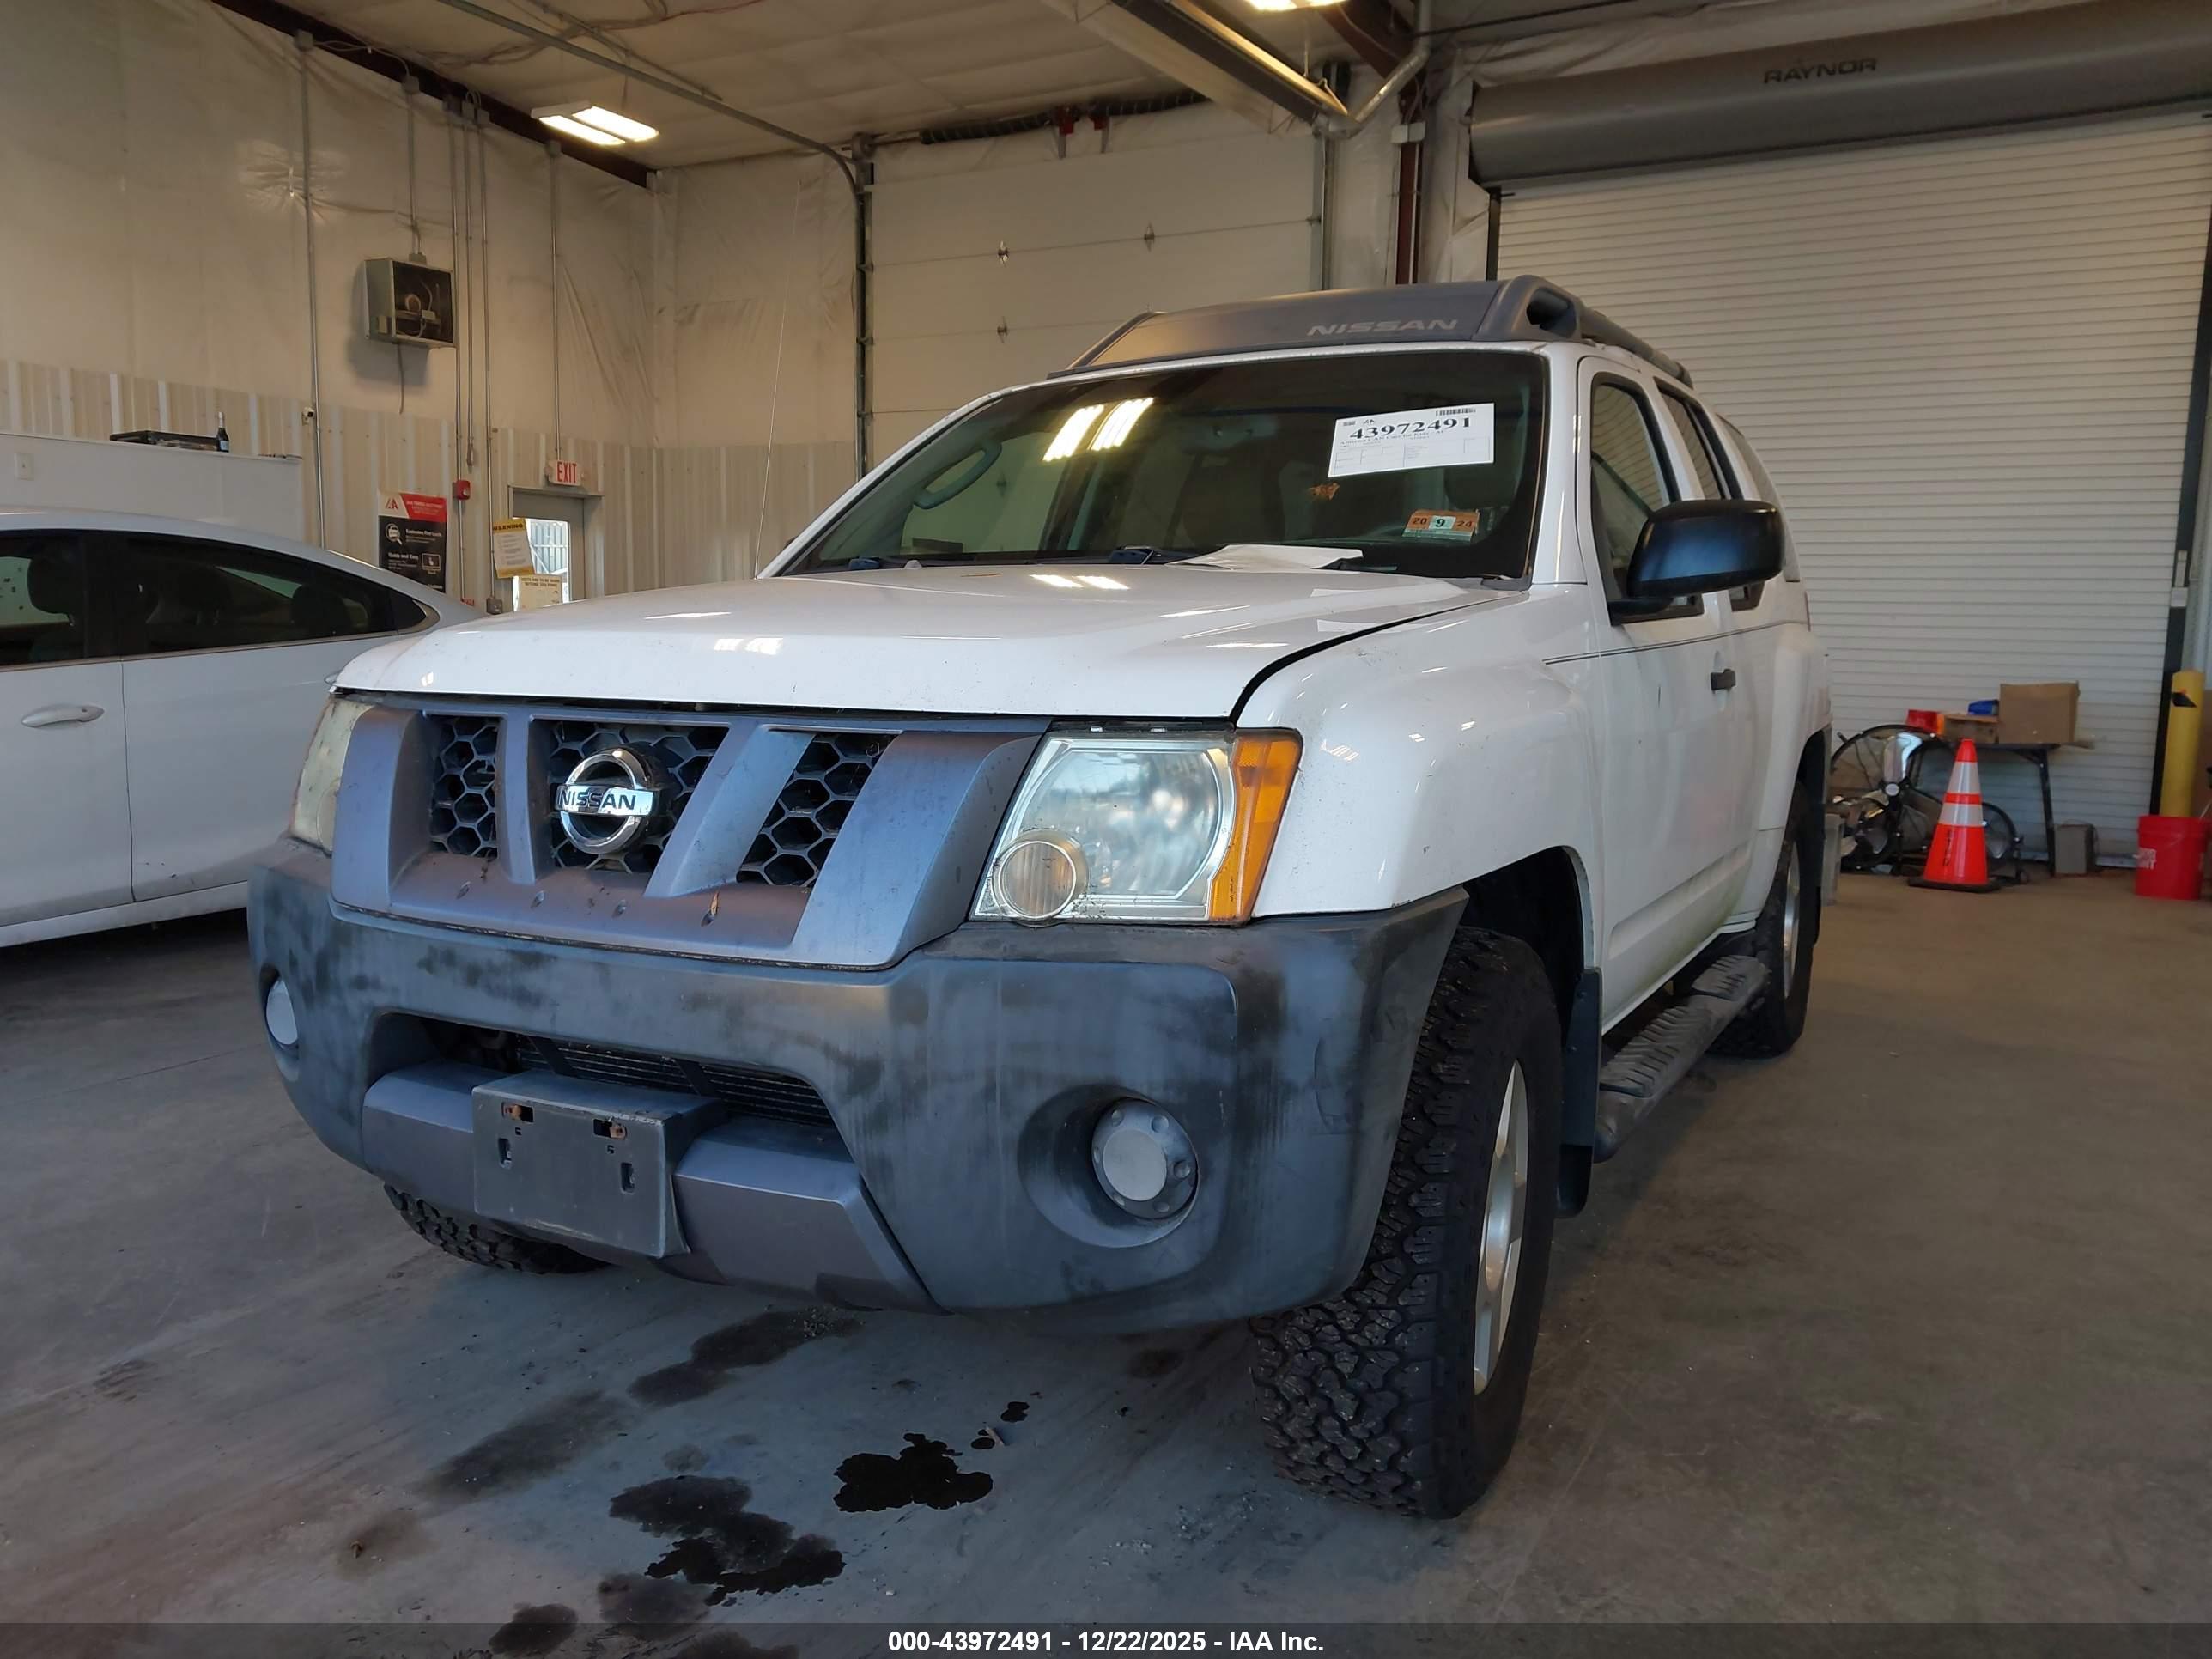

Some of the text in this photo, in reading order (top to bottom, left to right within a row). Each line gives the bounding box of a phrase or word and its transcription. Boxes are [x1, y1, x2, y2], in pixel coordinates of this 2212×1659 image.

[1764, 58, 1877, 83] RAYNOR
[1307, 319, 1458, 336] NISSAN
[1349, 417, 1470, 440] 43972491
[557, 461, 577, 483] EXIT
[1436, 518, 1445, 527] 9
[557, 790, 636, 810] NISSAN
